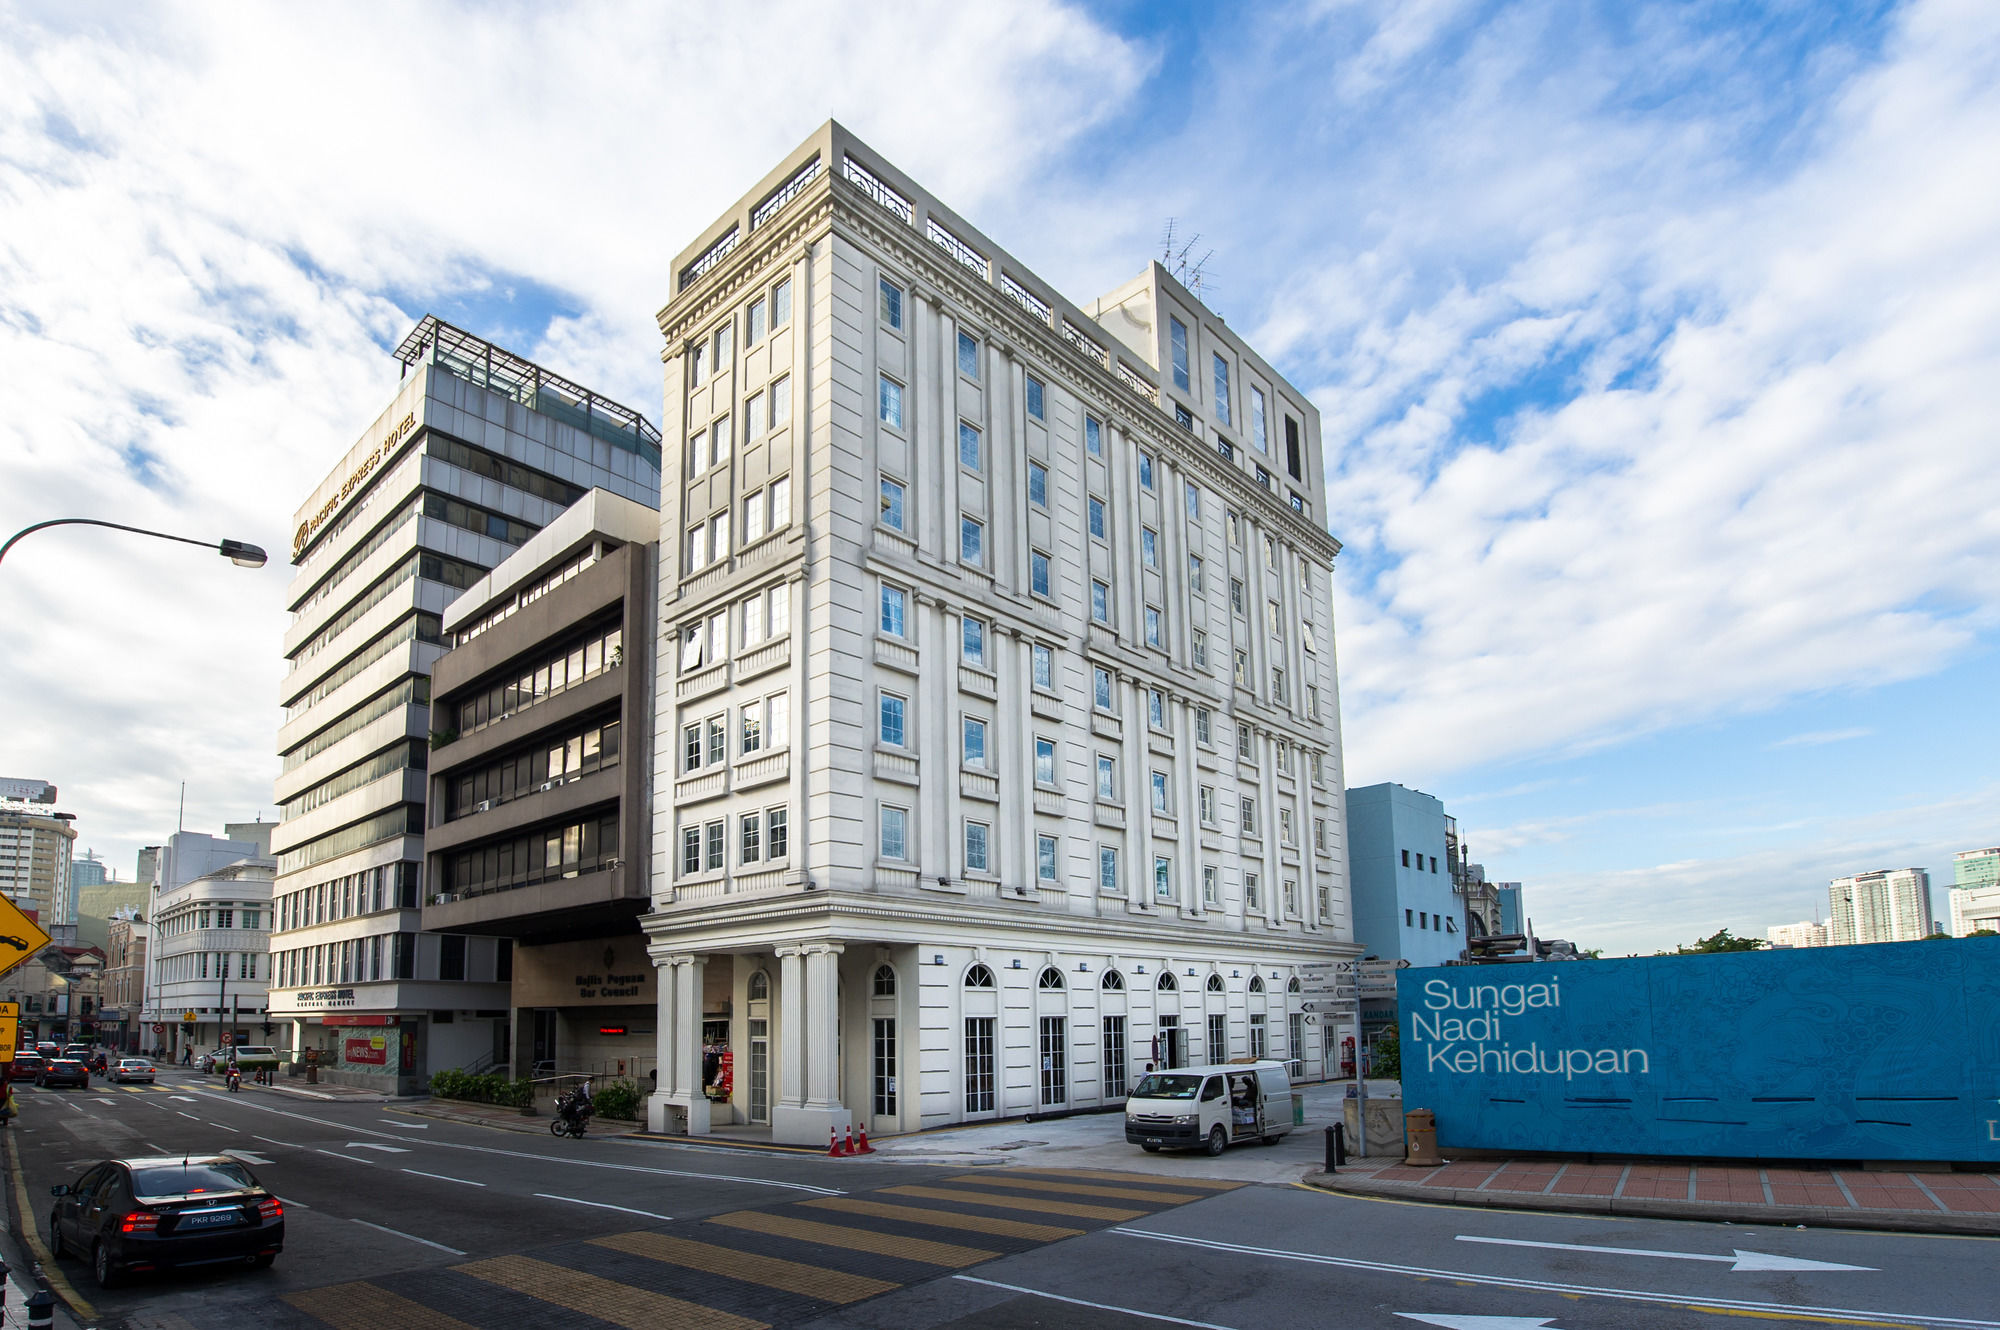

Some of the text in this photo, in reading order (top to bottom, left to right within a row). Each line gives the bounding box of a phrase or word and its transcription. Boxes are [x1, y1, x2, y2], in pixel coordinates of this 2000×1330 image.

[309, 412, 416, 535] PACIFIC EXPRESS HOTEL
[600, 985, 638, 997] Council
[1424, 975, 1560, 1015] Sungai
[1412, 1010, 1500, 1041] Nadi
[1427, 1042, 1649, 1081] Kehidupan
[191, 1214, 232, 1225] PKR 9269
